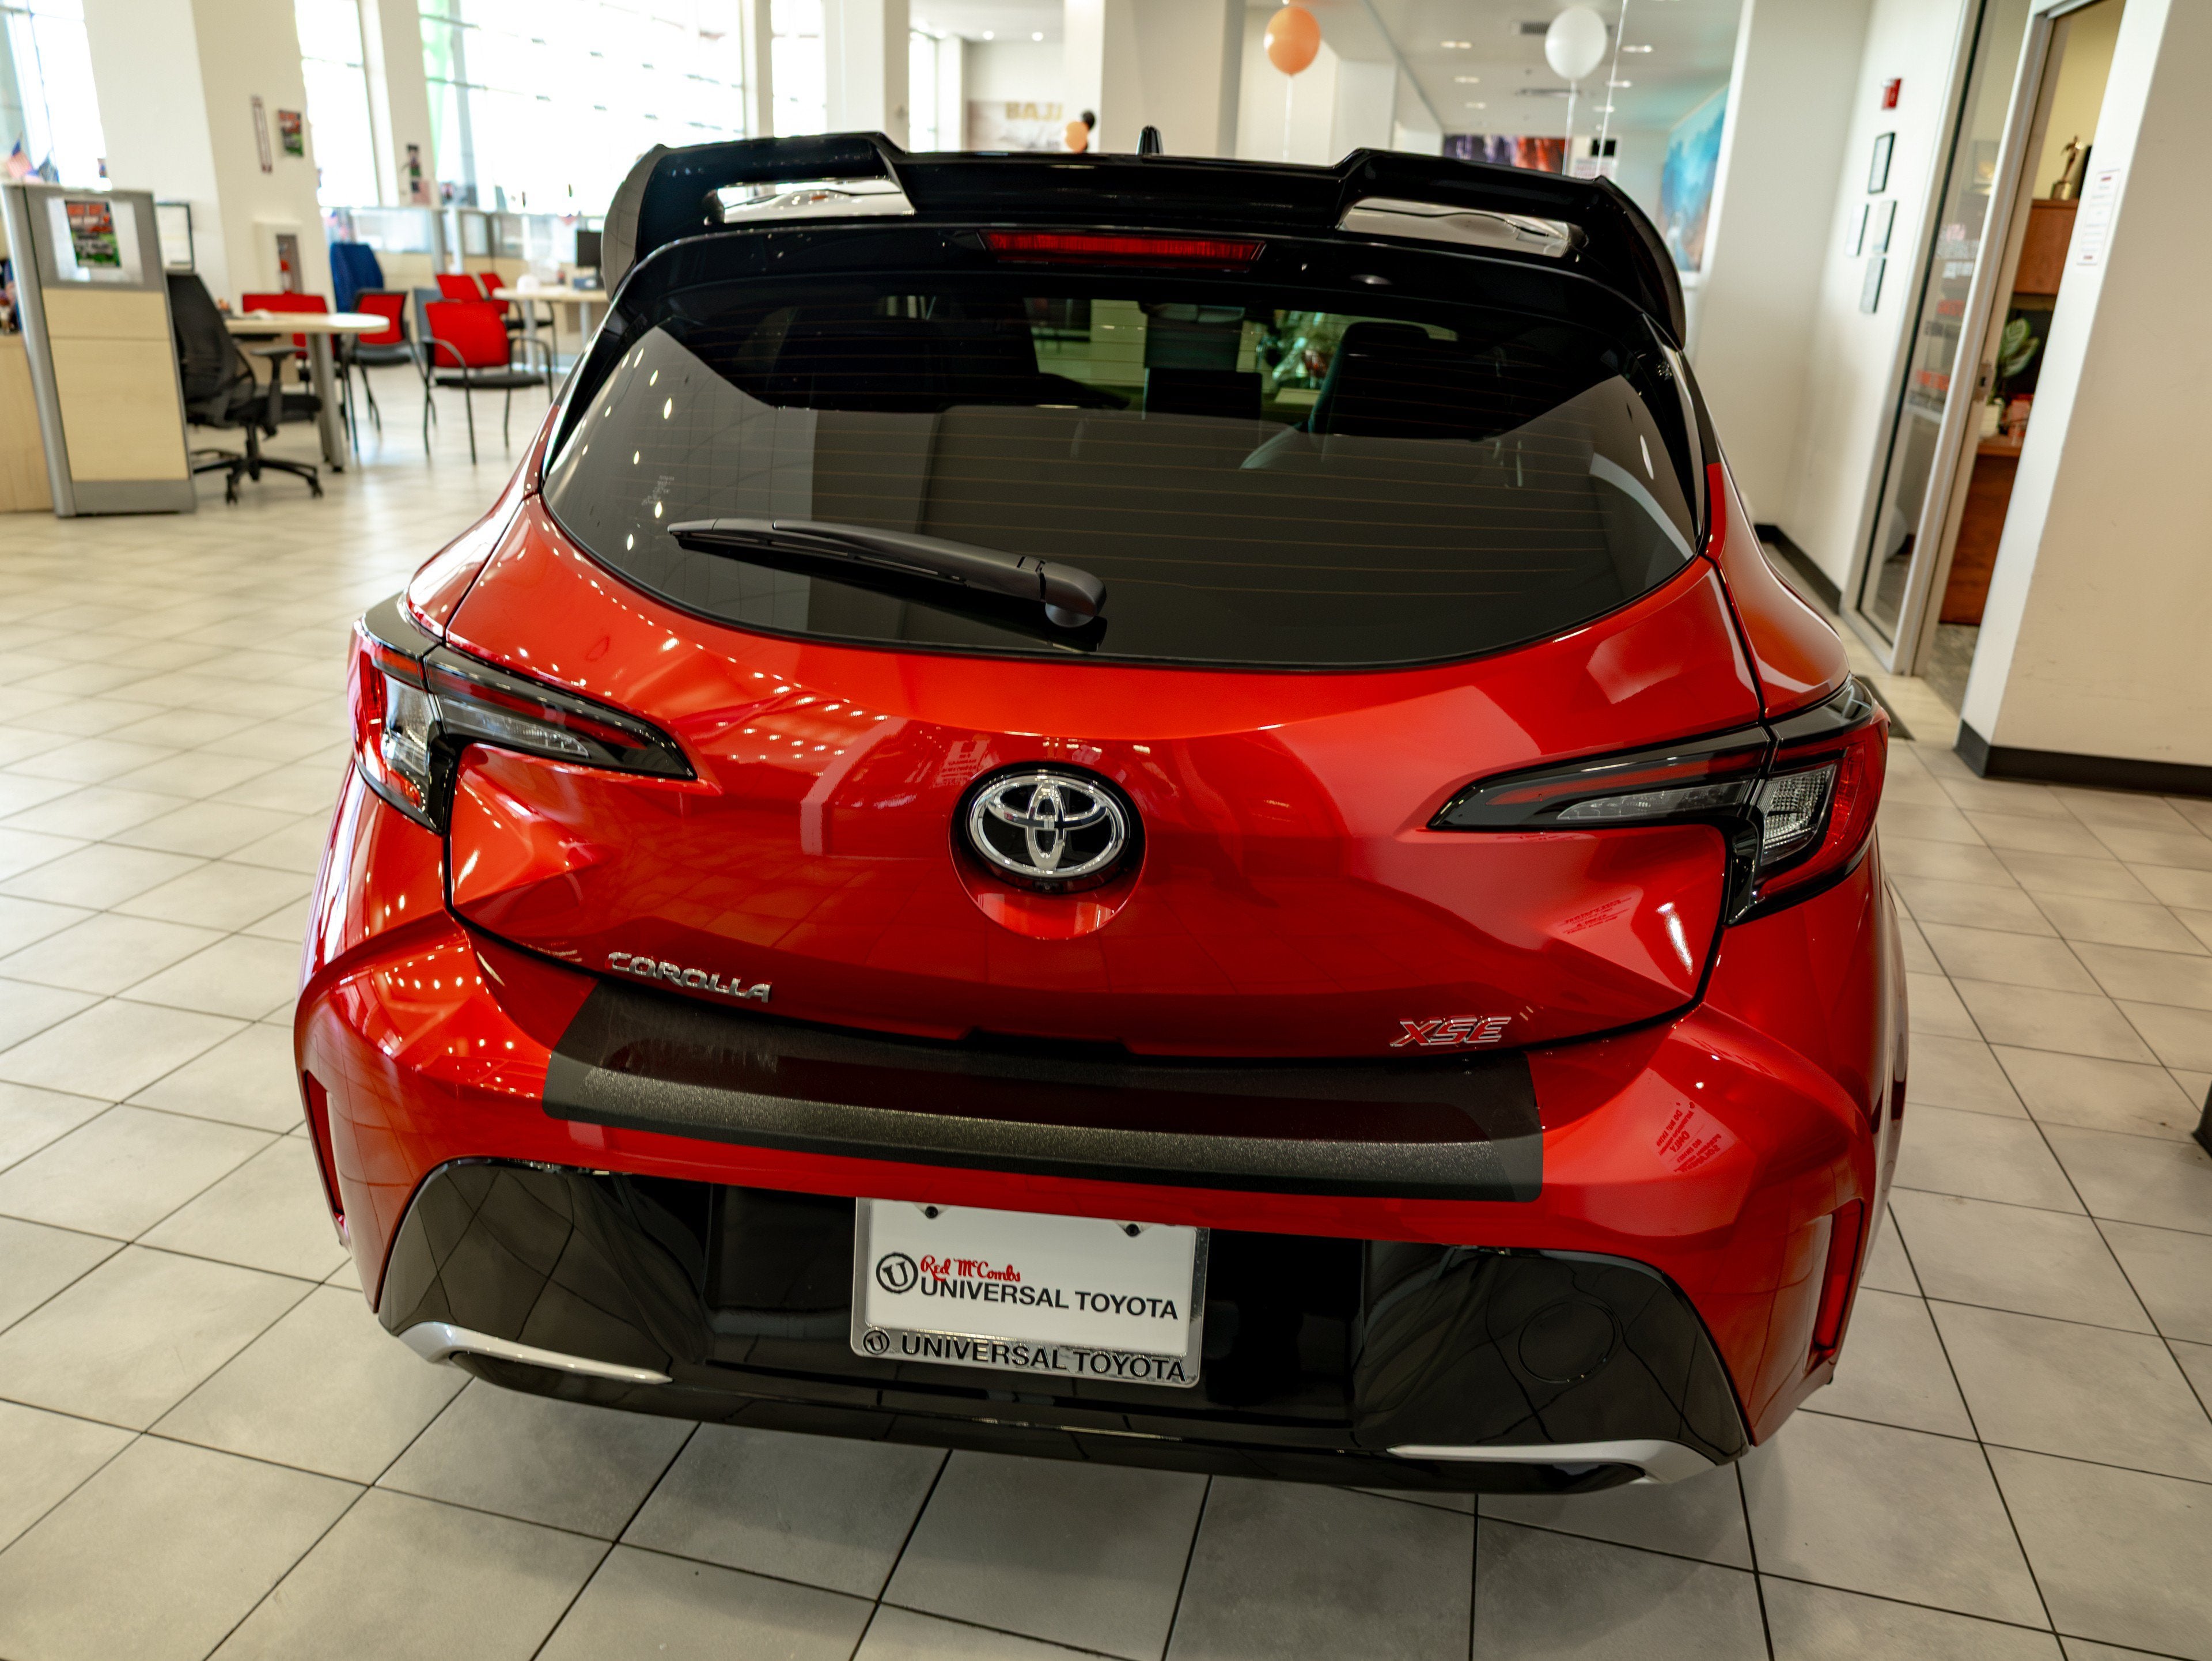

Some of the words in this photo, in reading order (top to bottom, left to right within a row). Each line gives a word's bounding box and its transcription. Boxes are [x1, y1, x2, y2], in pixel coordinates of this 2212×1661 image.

[608, 951, 772, 1003] COROLLA
[1389, 1015, 1512, 1047] XSE
[920, 1254, 952, 1282] Red
[953, 1257, 1022, 1282] McCombs
[921, 1276, 1069, 1309] UNIVERSAL
[1075, 1291, 1179, 1321] TOYOTA
[901, 1332, 1069, 1371] UNIVERSAL
[1073, 1349, 1188, 1382] TOYOTA
